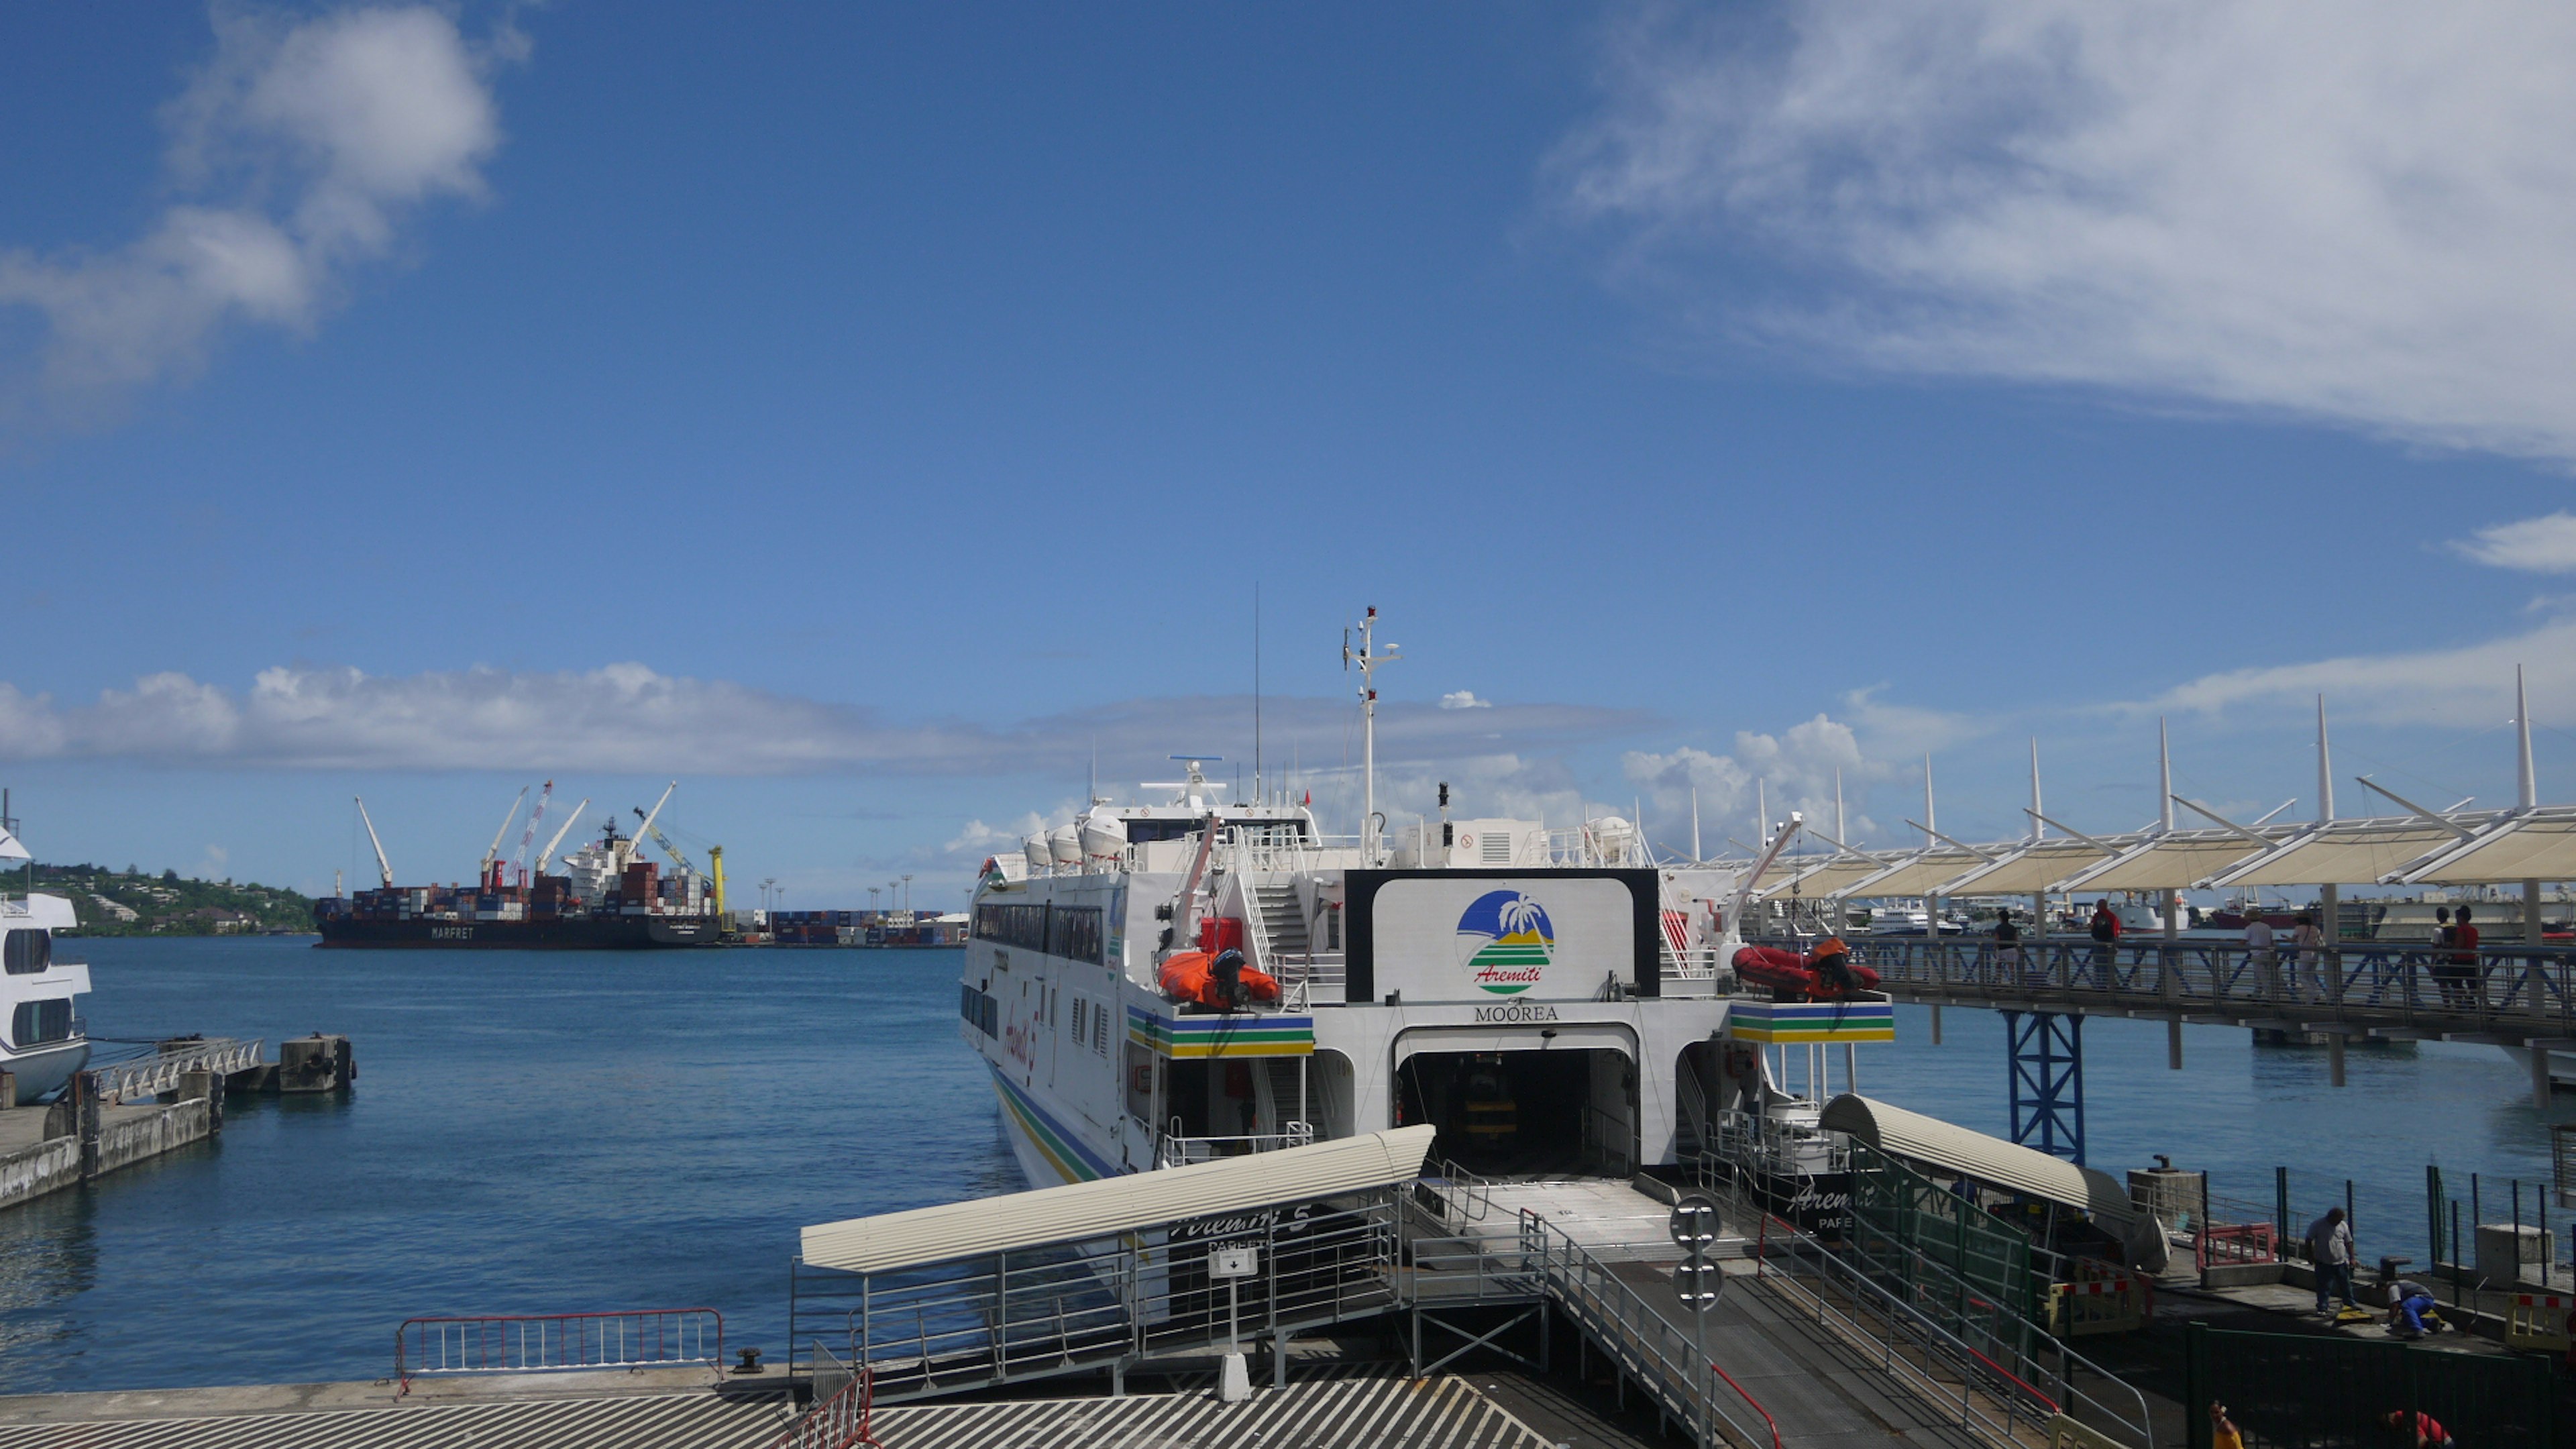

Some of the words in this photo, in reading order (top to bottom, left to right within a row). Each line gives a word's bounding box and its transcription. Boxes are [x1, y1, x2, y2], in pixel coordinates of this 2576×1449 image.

[431, 927, 474, 939] MARFRET
[1474, 963, 1542, 982] Aremiti
[1474, 1006, 1558, 1022] MOOREA
[1289, 1205, 1311, 1232] 5
